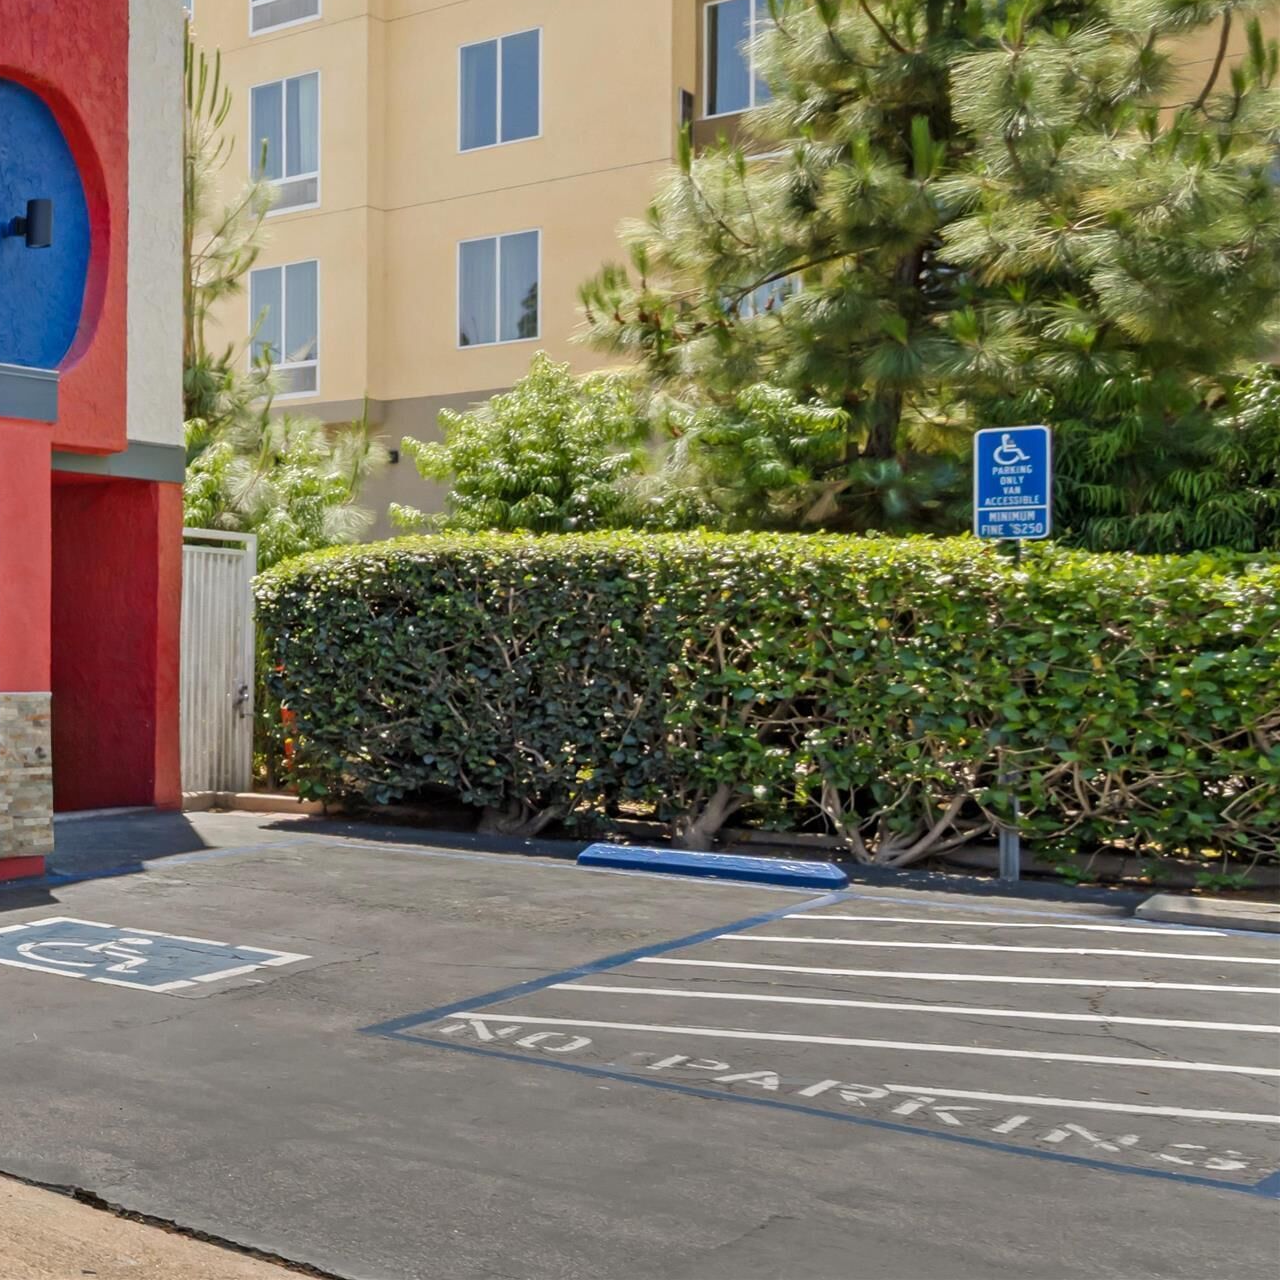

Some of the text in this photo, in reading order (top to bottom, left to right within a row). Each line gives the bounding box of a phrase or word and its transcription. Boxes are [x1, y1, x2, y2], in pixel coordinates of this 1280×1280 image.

[992, 465, 1032, 475] PARKING
[1000, 476, 1024, 485] ONLY
[1003, 486, 1021, 495] VAN
[984, 495, 1040, 506] ACCESSIBLE
[989, 510, 1035, 522] MINIMUM
[981, 522, 1043, 535] FINE $250
[440, 1019, 1250, 1171] NO PARKING
